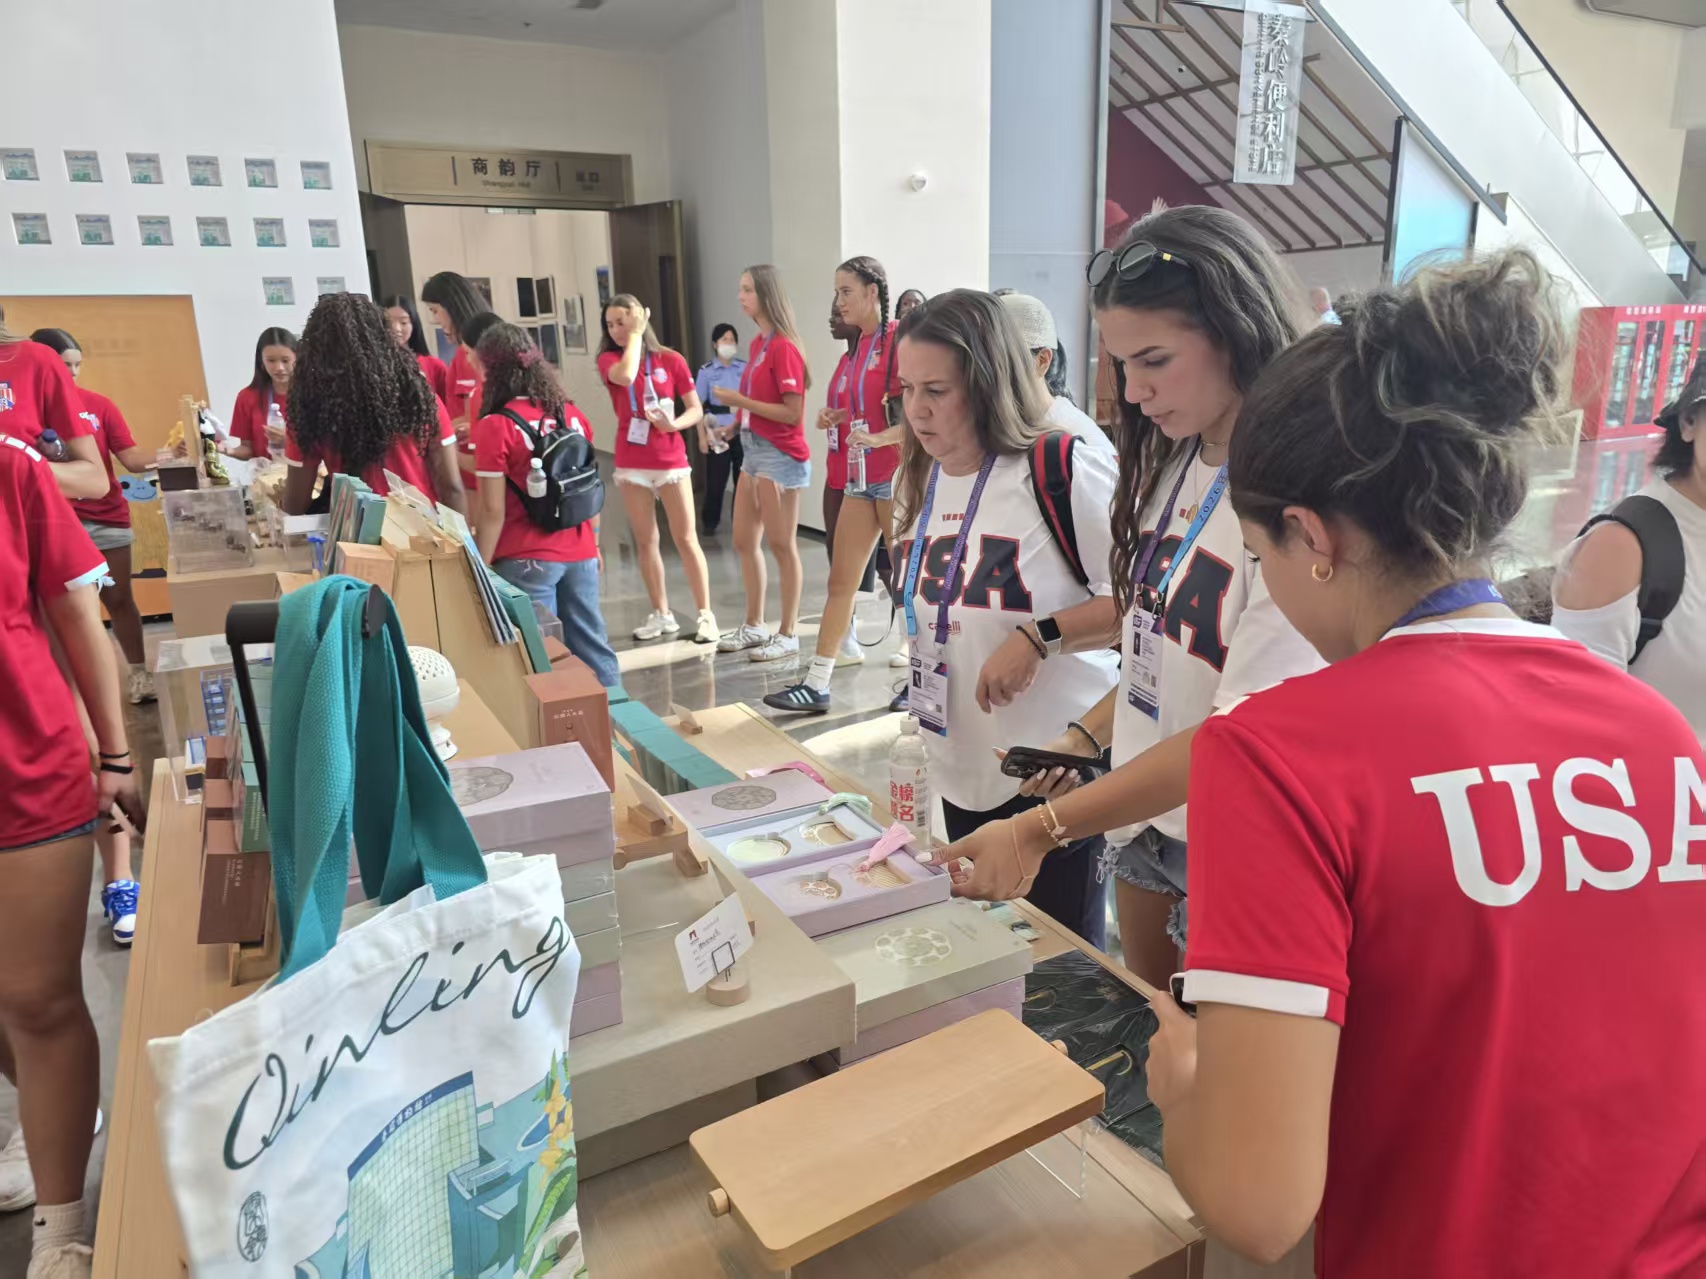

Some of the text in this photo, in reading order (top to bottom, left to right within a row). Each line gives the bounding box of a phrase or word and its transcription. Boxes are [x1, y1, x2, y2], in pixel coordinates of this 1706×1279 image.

[471, 157, 541, 177] 商韵厅
[223, 916, 571, 1170] Qinling
